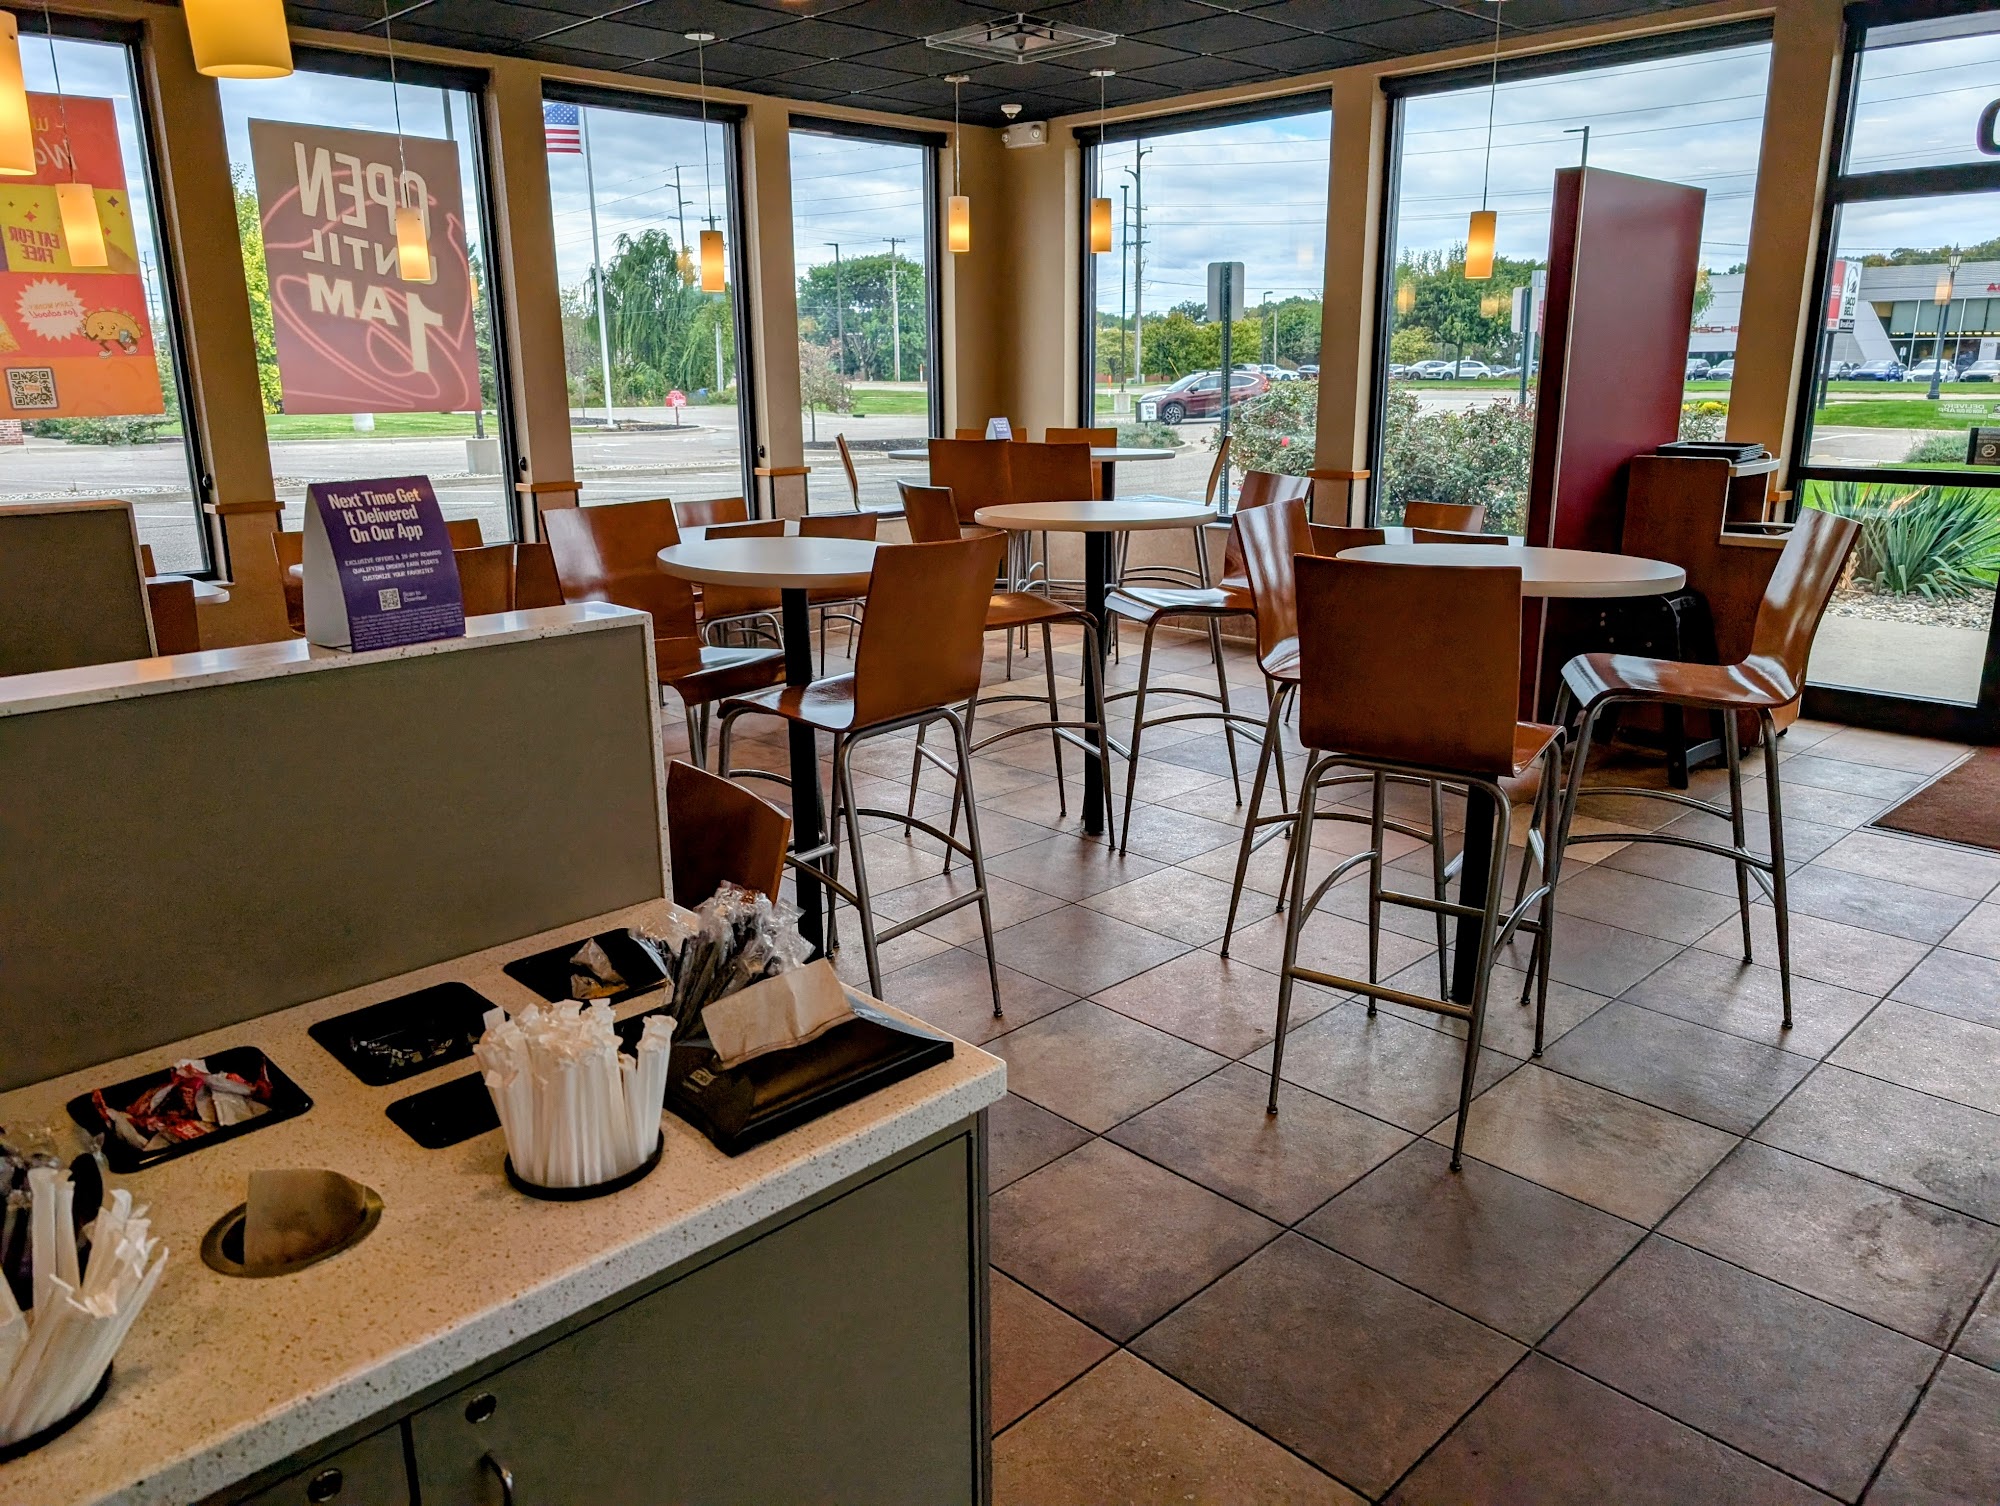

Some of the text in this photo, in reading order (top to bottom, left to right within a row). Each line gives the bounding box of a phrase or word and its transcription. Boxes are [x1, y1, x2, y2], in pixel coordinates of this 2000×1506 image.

[1845, 296, 1856, 307] TACO
[1843, 306, 1854, 316] BELL
[327, 487, 422, 510] Next Time Get
[342, 504, 419, 526] It Delivered
[349, 522, 424, 544] On Our App
[344, 557, 374, 567] EXCLUSIVE
[374, 554, 395, 562] OFFERS
[419, 549, 442, 557] REWARDS
[352, 565, 385, 575] QUALIFYING
[385, 562, 405, 570] ORDERS
[420, 558, 440, 566] POINTS
[362, 567, 434, 582] CUSTOMIZE YOUR FAVORITES
